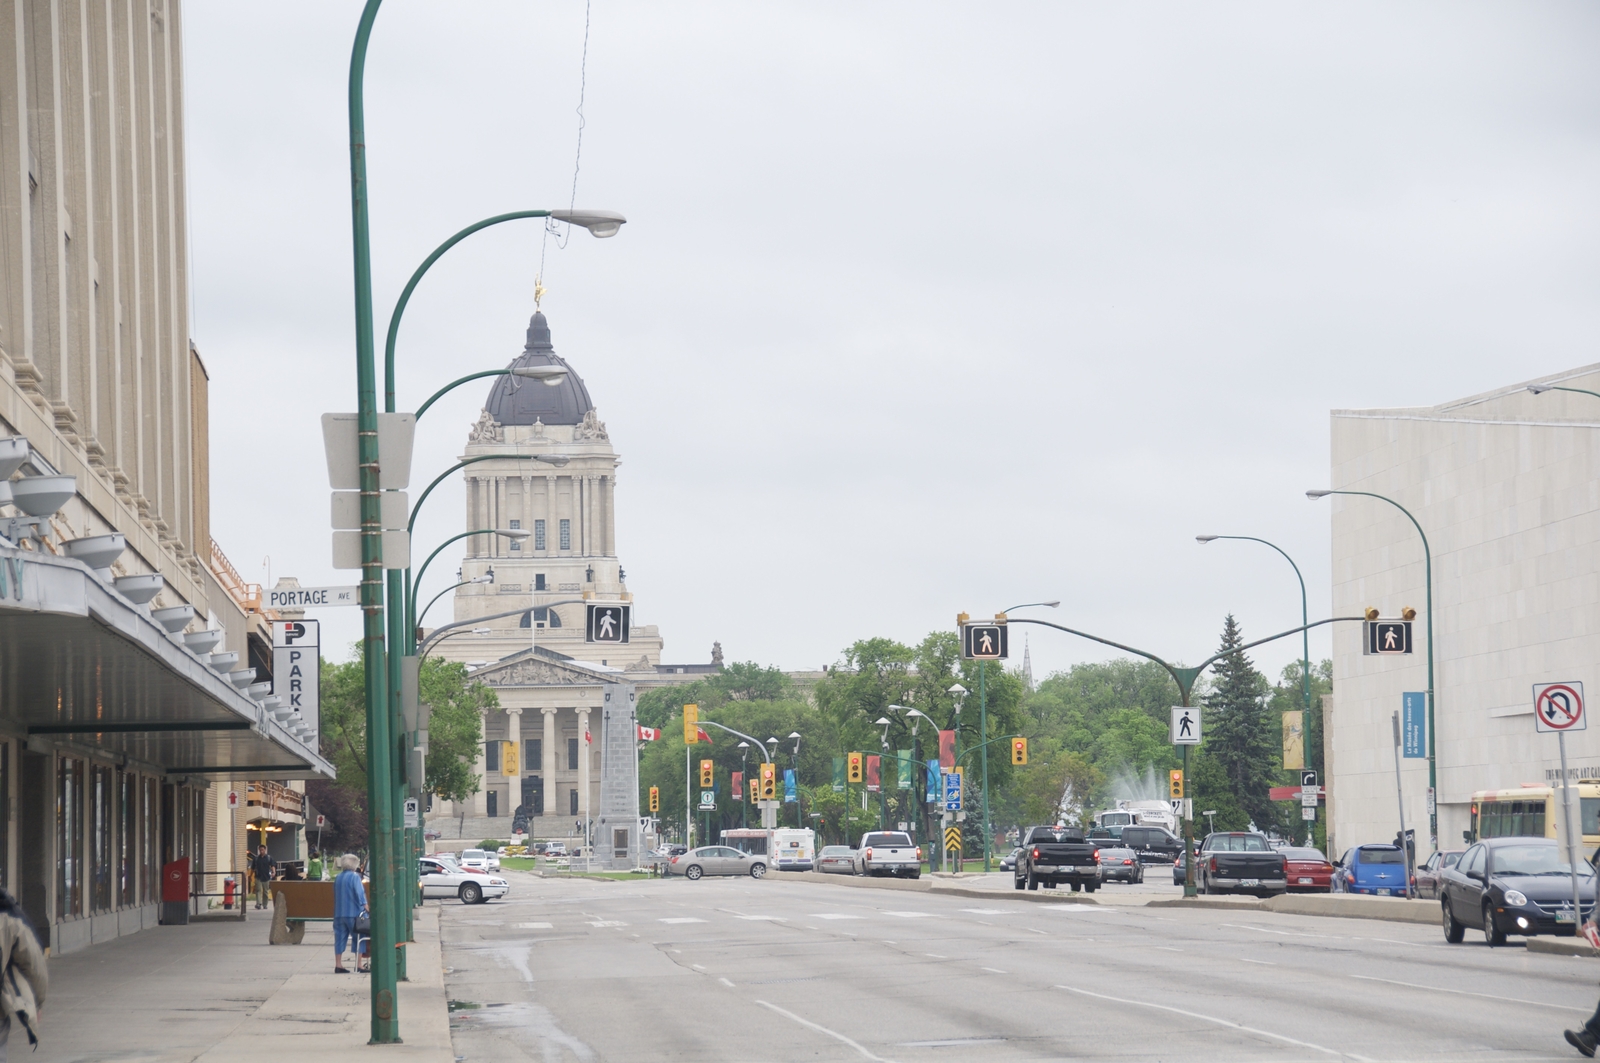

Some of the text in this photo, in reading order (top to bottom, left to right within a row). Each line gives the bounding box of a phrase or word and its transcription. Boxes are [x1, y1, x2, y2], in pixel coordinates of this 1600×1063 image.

[270, 590, 350, 606] PORTAGE AVE
[289, 651, 303, 720] PARK
[1580, 767, 1590, 778] ART
